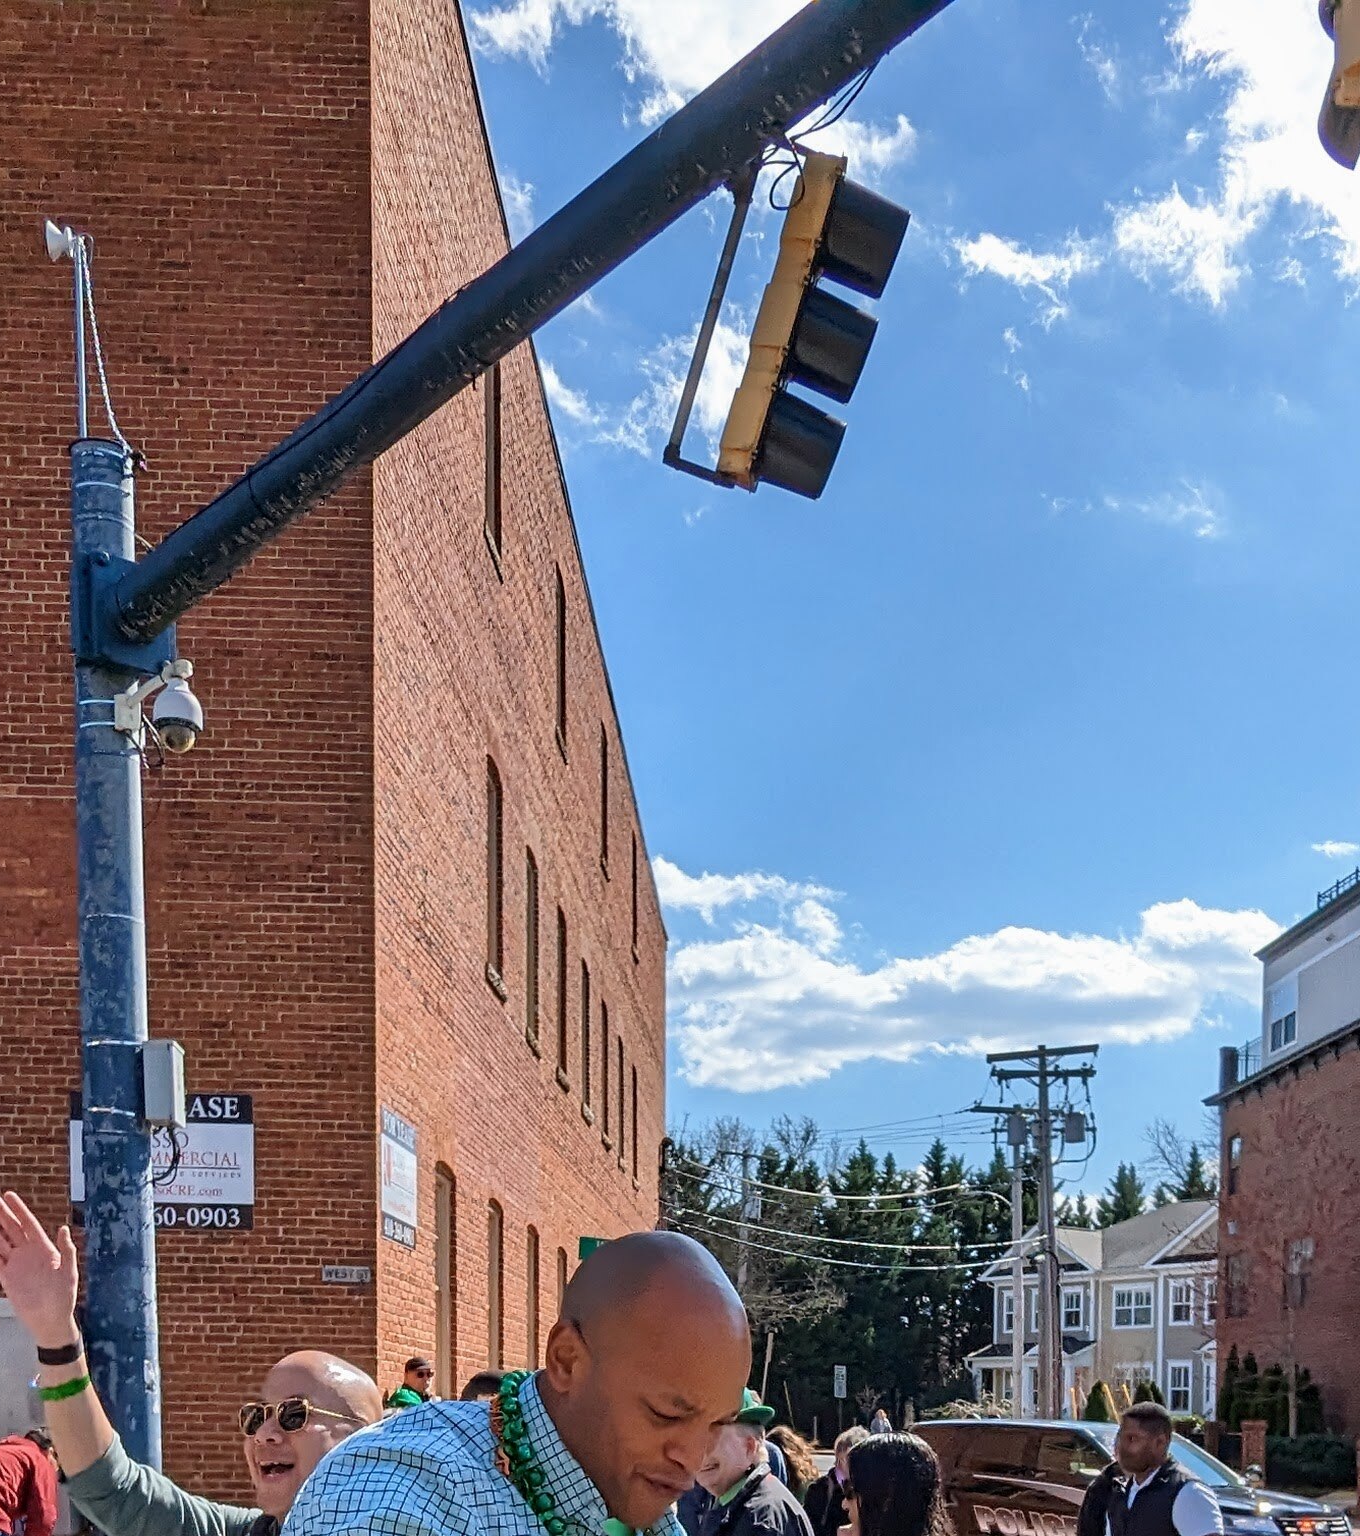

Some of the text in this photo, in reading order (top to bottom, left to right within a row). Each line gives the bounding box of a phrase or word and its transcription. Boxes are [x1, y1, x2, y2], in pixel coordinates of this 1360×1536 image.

[188, 1096, 240, 1119] ASE
[152, 1131, 189, 1149] SSO
[152, 1151, 240, 1168] MMERCIAL
[154, 1206, 241, 1228] 60-0903
